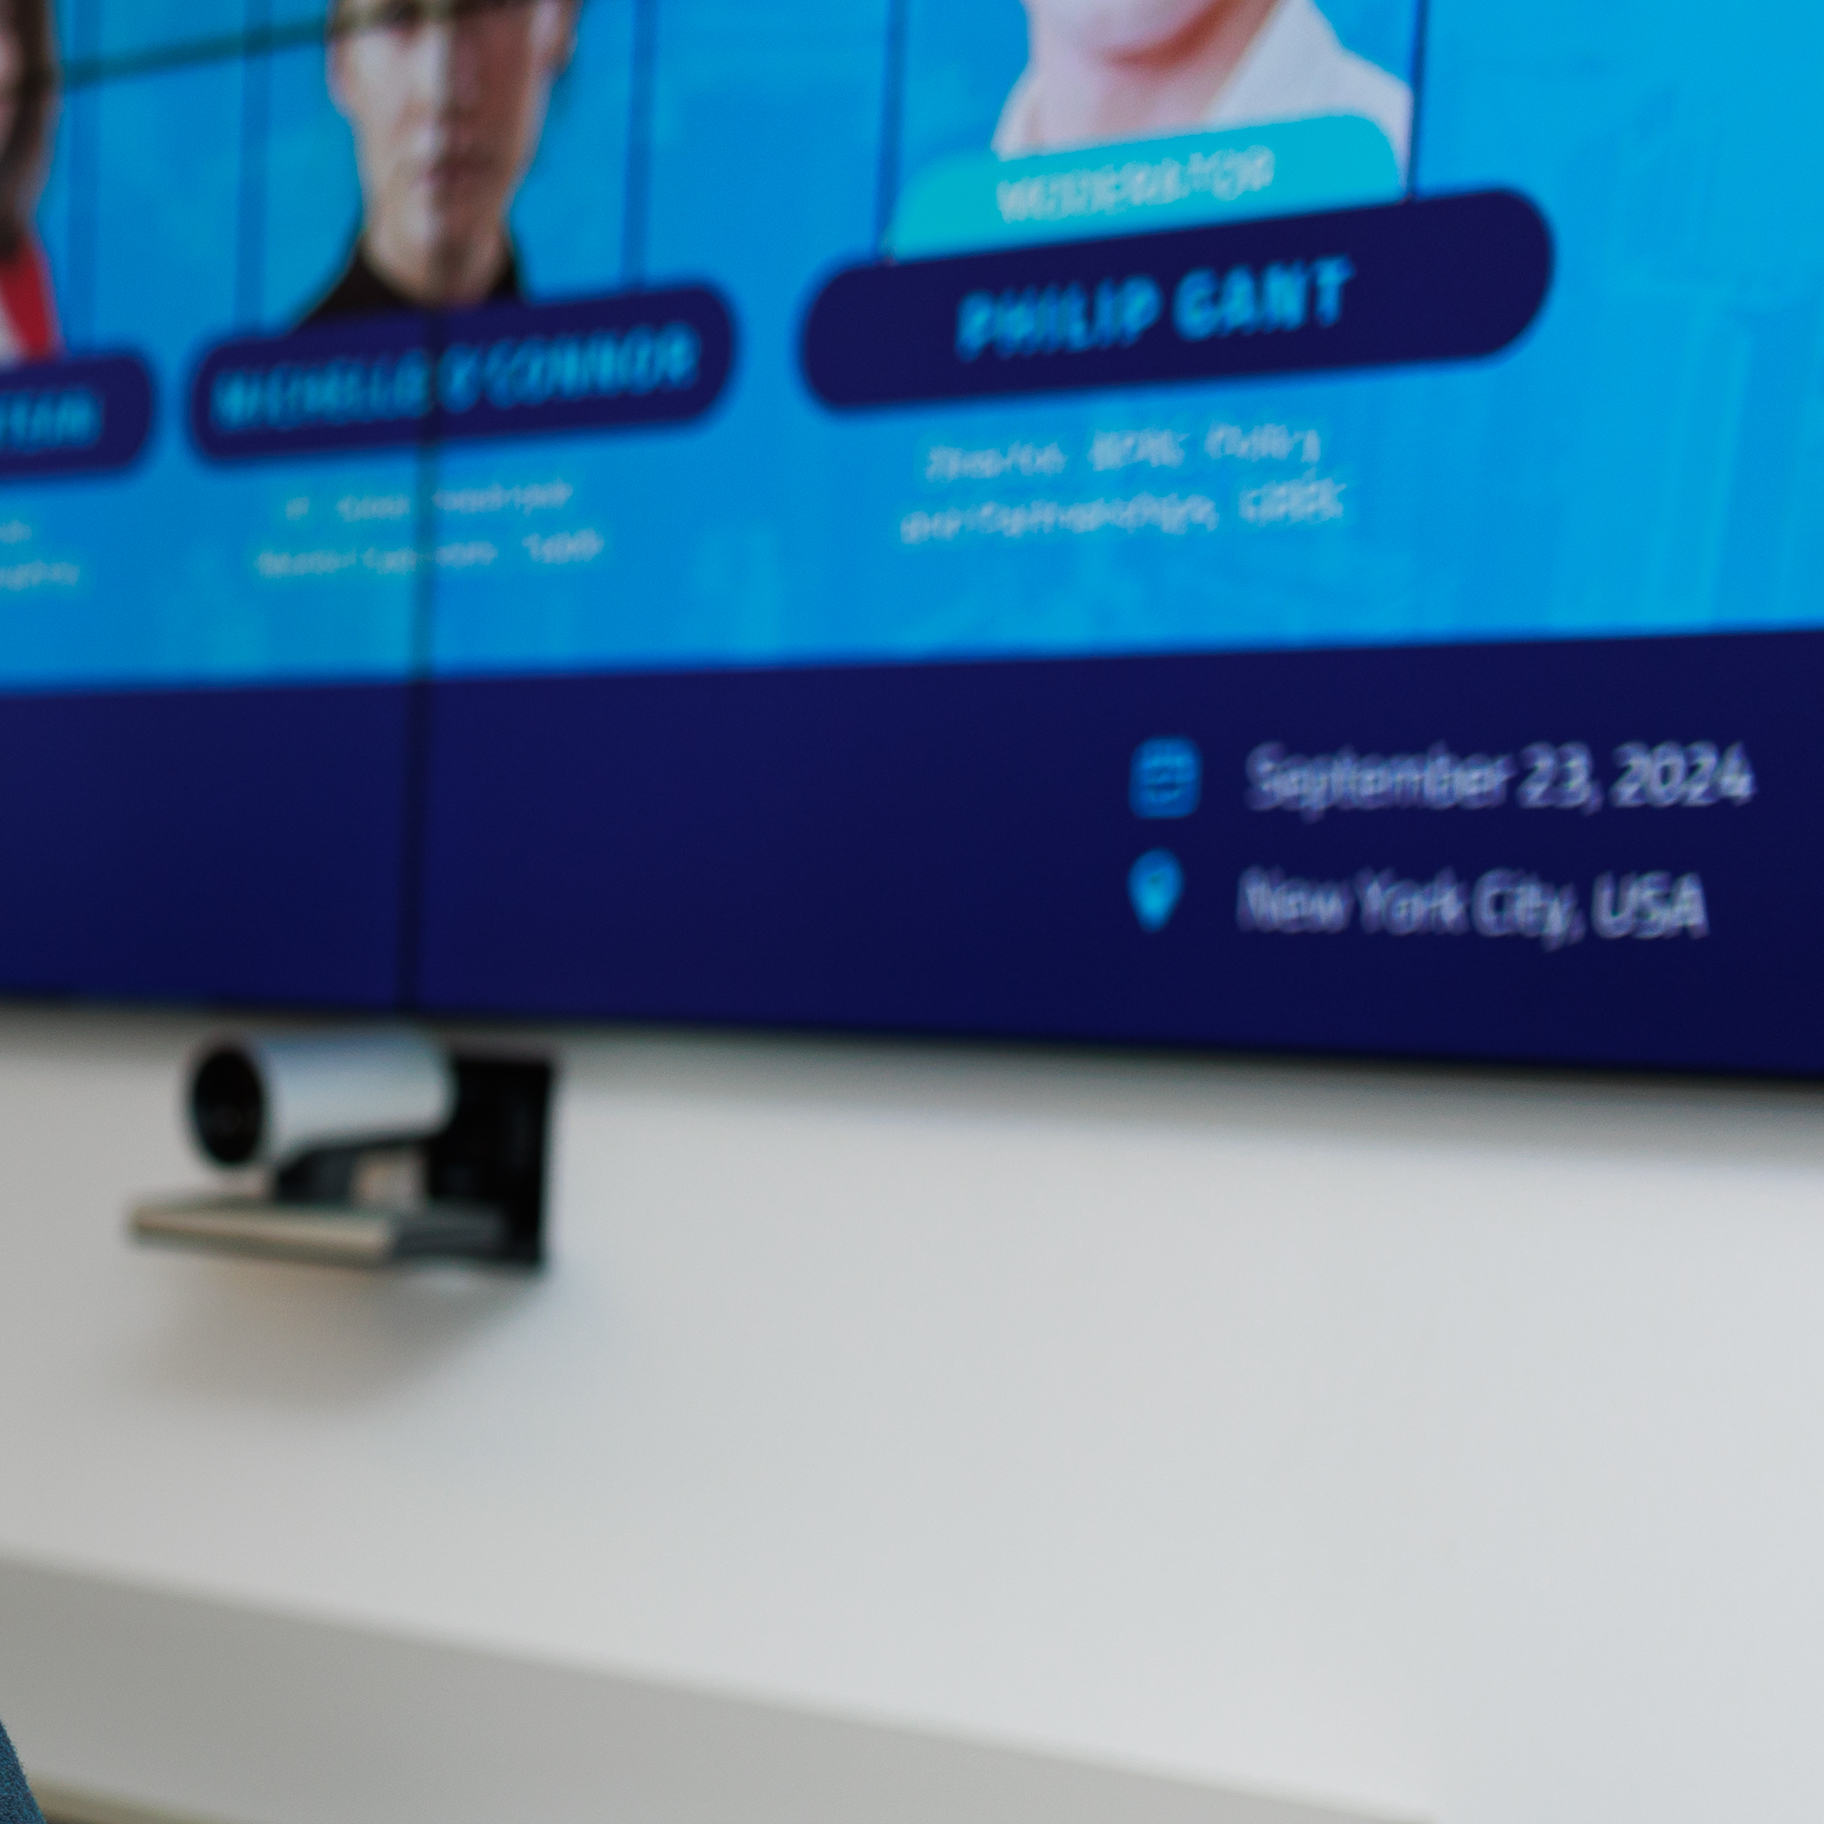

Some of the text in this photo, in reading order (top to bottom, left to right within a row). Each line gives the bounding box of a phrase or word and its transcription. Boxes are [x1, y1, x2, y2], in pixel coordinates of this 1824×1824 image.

[996, 145, 1275, 224] MODERATOR
[956, 254, 1355, 361] PHILIP GANT
[1246, 740, 1758, 824] September 23, 2024
[1236, 865, 1710, 951] New York City, USA
